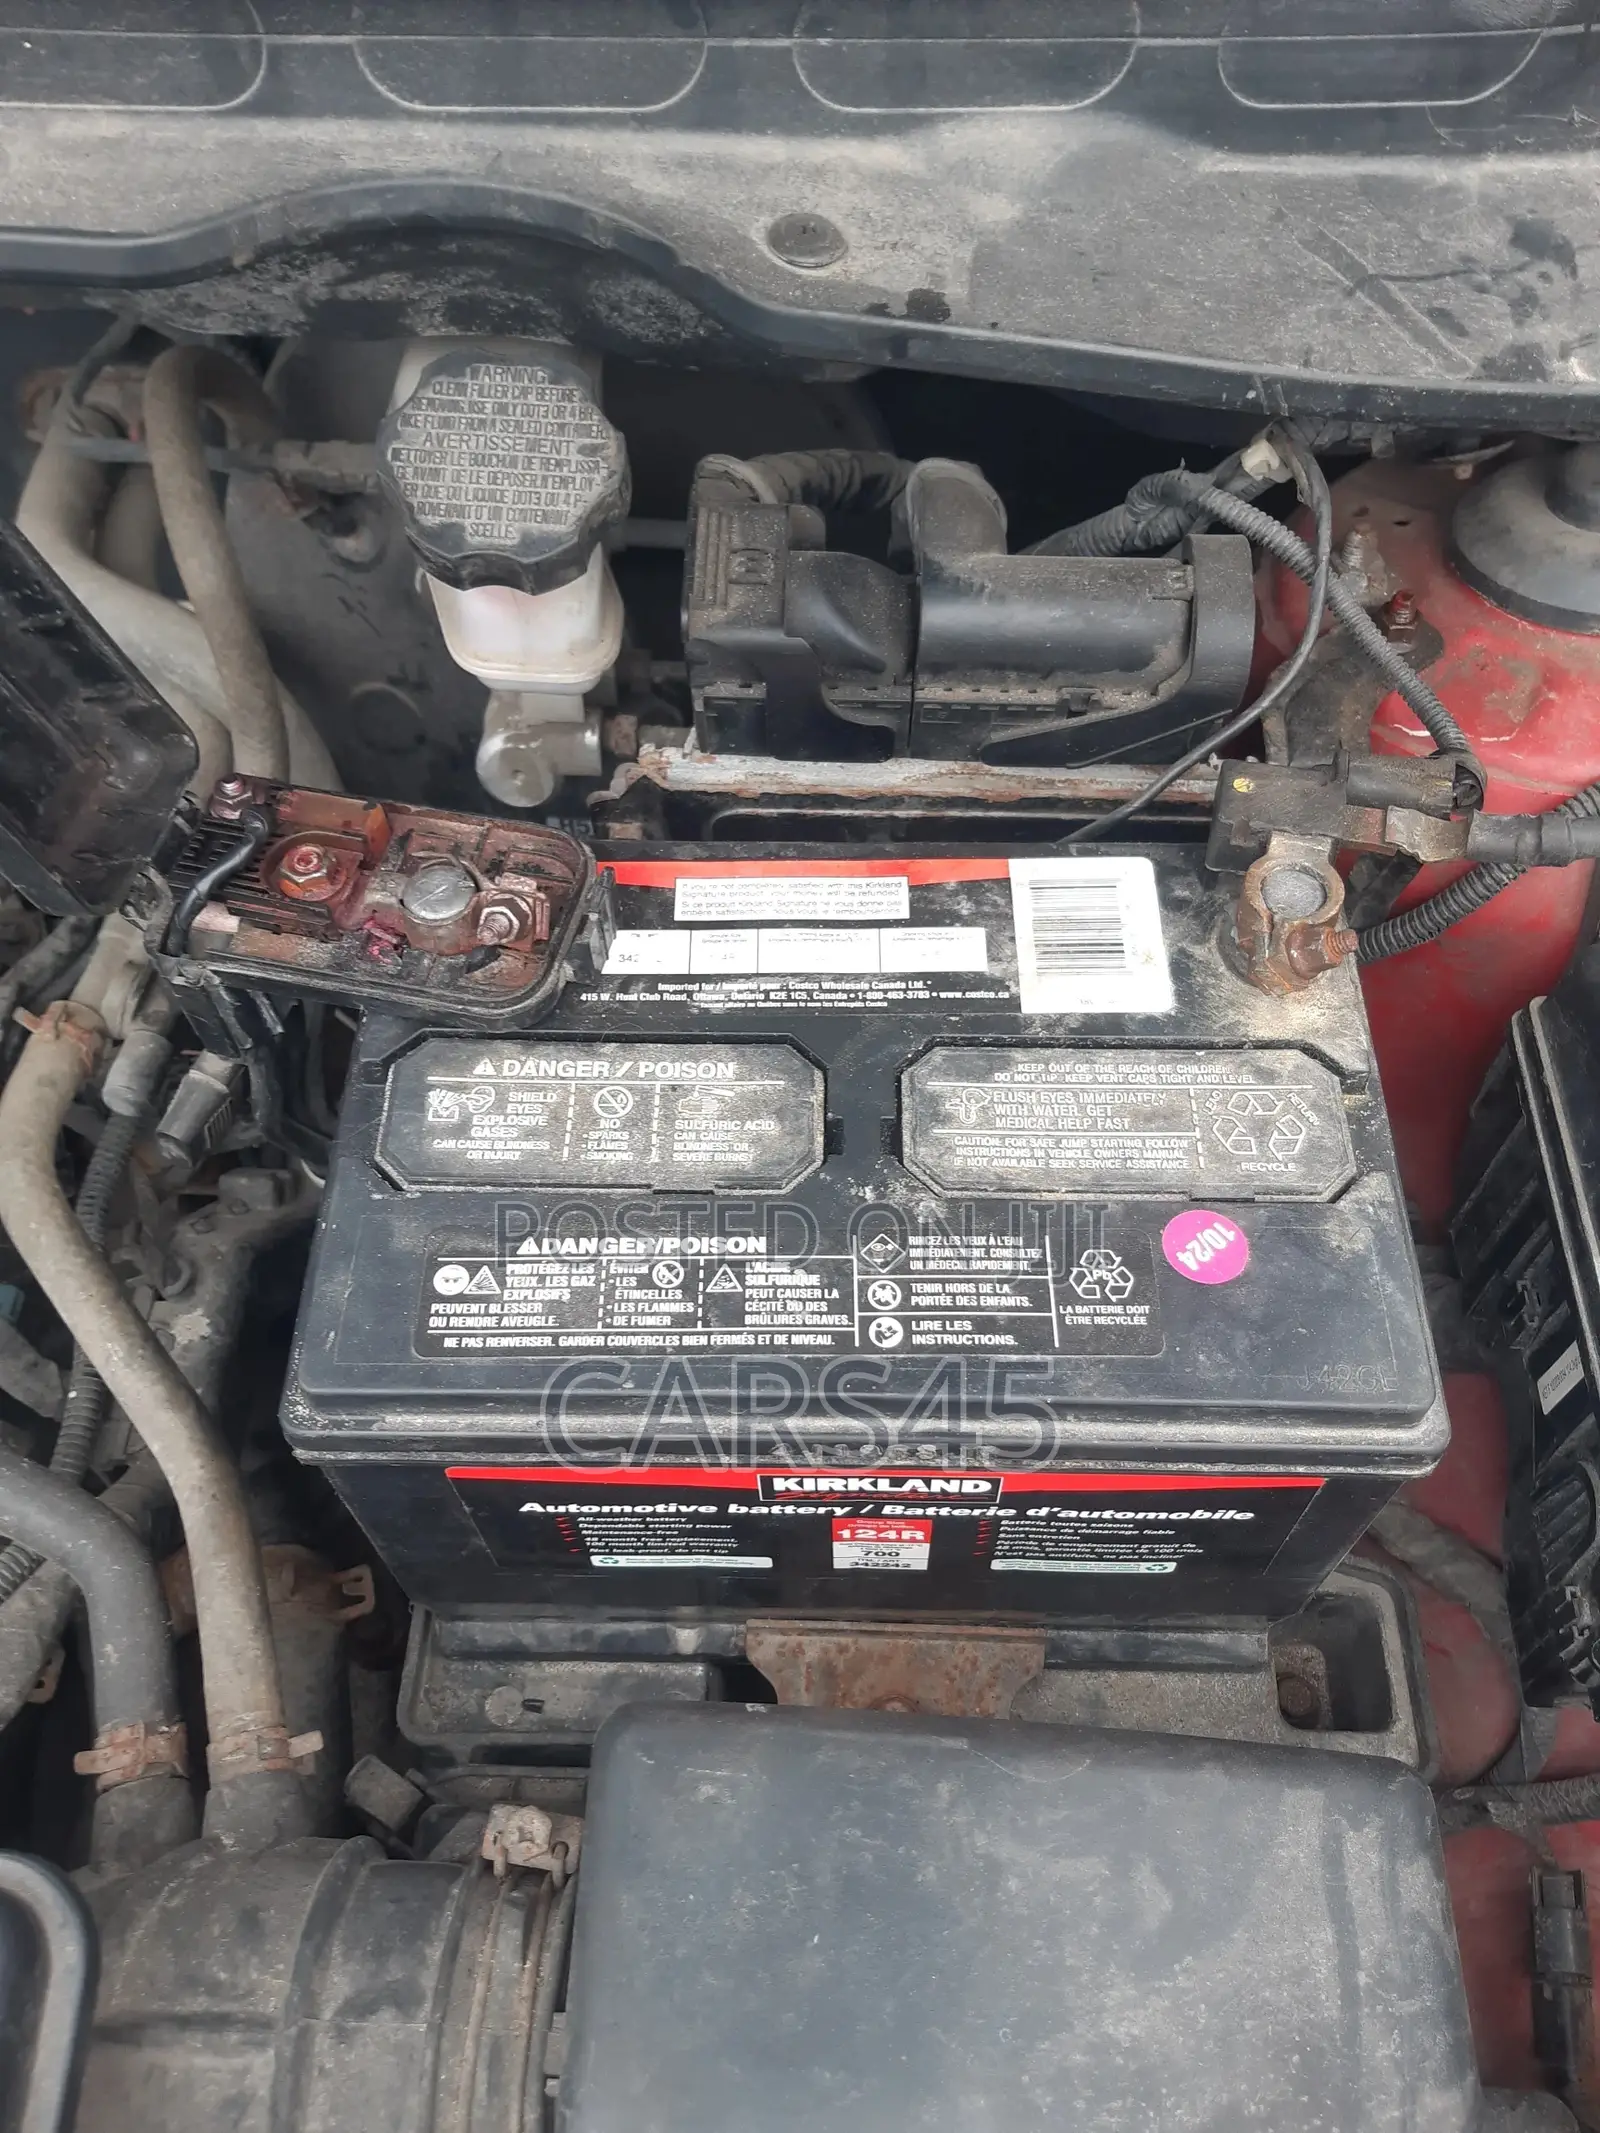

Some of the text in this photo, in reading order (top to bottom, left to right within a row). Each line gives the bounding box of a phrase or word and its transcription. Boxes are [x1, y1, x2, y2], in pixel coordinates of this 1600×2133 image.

[658, 982, 700, 992] Imported
[788, 981, 818, 990] Costco
[820, 981, 870, 990] Wholesale
[872, 980, 906, 990] Canada
[580, 993, 598, 1001] 415
[813, 991, 848, 1000] Canada
[938, 990, 1010, 999] www.costco.ca
[502, 1059, 736, 1079] DANGER POISON
[1018, 1063, 1044, 1073] KEEP
[1049, 1063, 1071, 1073] OUT
[1075, 1064, 1091, 1073] OF
[1095, 1064, 1115, 1073] THE
[1118, 1064, 1154, 1074] REACH
[1158, 1065, 1173, 1074] OF
[994, 1072, 1011, 1082] DO
[1014, 1073, 1036, 1082] NOT
[1065, 1073, 1093, 1083] KEEP
[1097, 1074, 1126, 1083] VENT
[1128, 1074, 1156, 1084] CAPS
[1160, 1074, 1193, 1083] TIGHT
[1196, 1075, 1220, 1084] AND
[508, 1091, 557, 1103] SHIELD
[993, 1092, 1036, 1104] FLUSH
[506, 1103, 543, 1114] EYES
[994, 1104, 1029, 1116] WITH
[1086, 1105, 1113, 1117] GET
[472, 1115, 548, 1126] EXPLOSIVE
[600, 1119, 621, 1129] NO
[675, 1119, 776, 1131] SULFURIC ACID
[995, 1117, 1131, 1130] MEDICAL HELP FAST
[470, 1126, 519, 1138] GASES
[588, 1131, 630, 1140] SPARKS
[674, 1131, 735, 1141] CAN CAUSE
[433, 1139, 456, 1149] CAN
[457, 1140, 492, 1149] CAUSE
[587, 1141, 629, 1151] FLAMES
[1241, 1161, 1297, 1172] RECYCLE
[1175, 1220, 1237, 1272] 10/24
[545, 1276, 568, 1287] LES
[570, 1275, 596, 1287] GAZ
[1092, 1269, 1113, 1281] Pb
[503, 1288, 571, 1301] EXPLOSIFS
[615, 1288, 683, 1300] ÉTINCELLES
[745, 1288, 774, 1299] PEUT
[777, 1288, 822, 1299] CAUSER
[911, 1283, 1011, 1294] TENIR HORS DE LA
[911, 1293, 1033, 1307] PORTÉE DES ENFANTS.
[431, 1302, 543, 1314] PEUVENT BLESSER
[613, 1302, 695, 1313] LES FLAMMES
[1060, 1305, 1151, 1315] LA BATTERIE DOIT
[429, 1315, 559, 1327] OU RENDRE AVEUGLE.
[613, 1316, 671, 1326] DE FUMER
[745, 1312, 854, 1326] BRÛLURES GRAVES.
[1065, 1314, 1148, 1325] ÊTRE RECYCLÉE
[912, 1320, 973, 1331] LIRE LES
[443, 1332, 836, 1348] NE PAS RENVERSER. GARDER COUVERCLES BIEN FERMÉS ET DE NIVEAU.
[912, 1334, 1019, 1346] INSTRUCTIONS.
[772, 1477, 993, 1493] KIRKLAND
[518, 1502, 718, 1514] Automotive
[727, 1502, 853, 1516] battery
[881, 1505, 1017, 1517] Batterie
[1026, 1506, 1256, 1521] d'automobile
[837, 1528, 925, 1541] 124R
